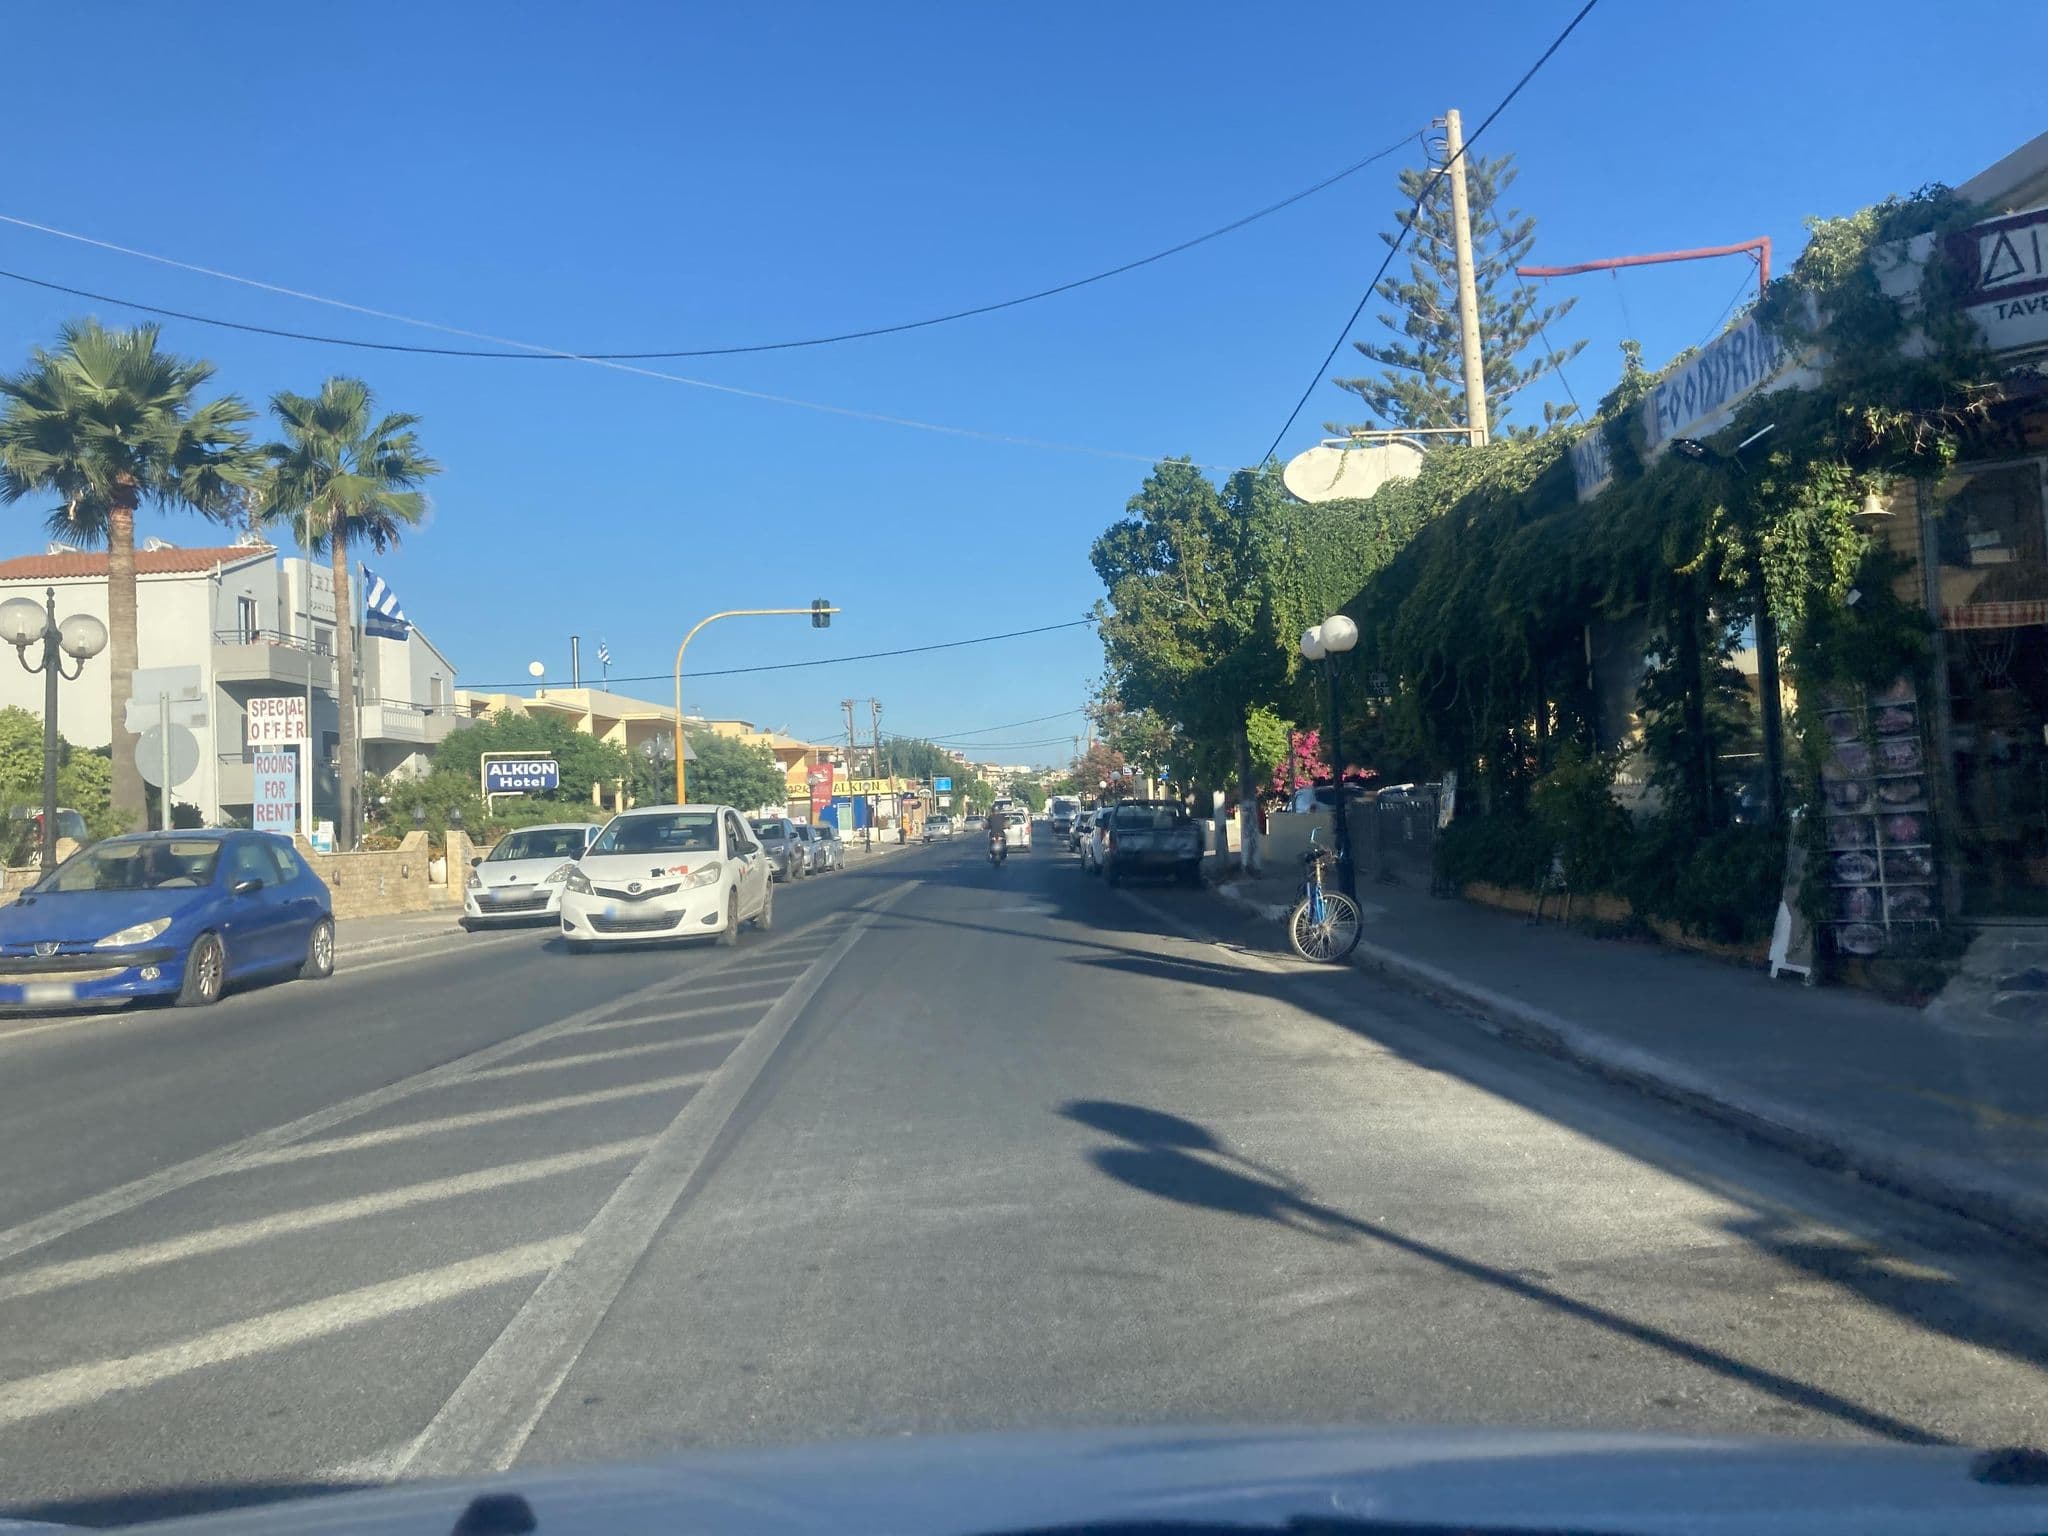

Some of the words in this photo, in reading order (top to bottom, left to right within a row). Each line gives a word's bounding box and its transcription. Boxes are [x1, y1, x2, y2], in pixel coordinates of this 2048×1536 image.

[251, 697, 304, 717] SPECIAL
[251, 721, 305, 740] OFFER
[256, 755, 294, 774] ROOMS
[489, 763, 555, 775] ALKION
[264, 780, 286, 799] FOR
[500, 776, 546, 787] Hotel
[833, 782, 880, 793] ALKIN
[256, 803, 293, 822] RENT
